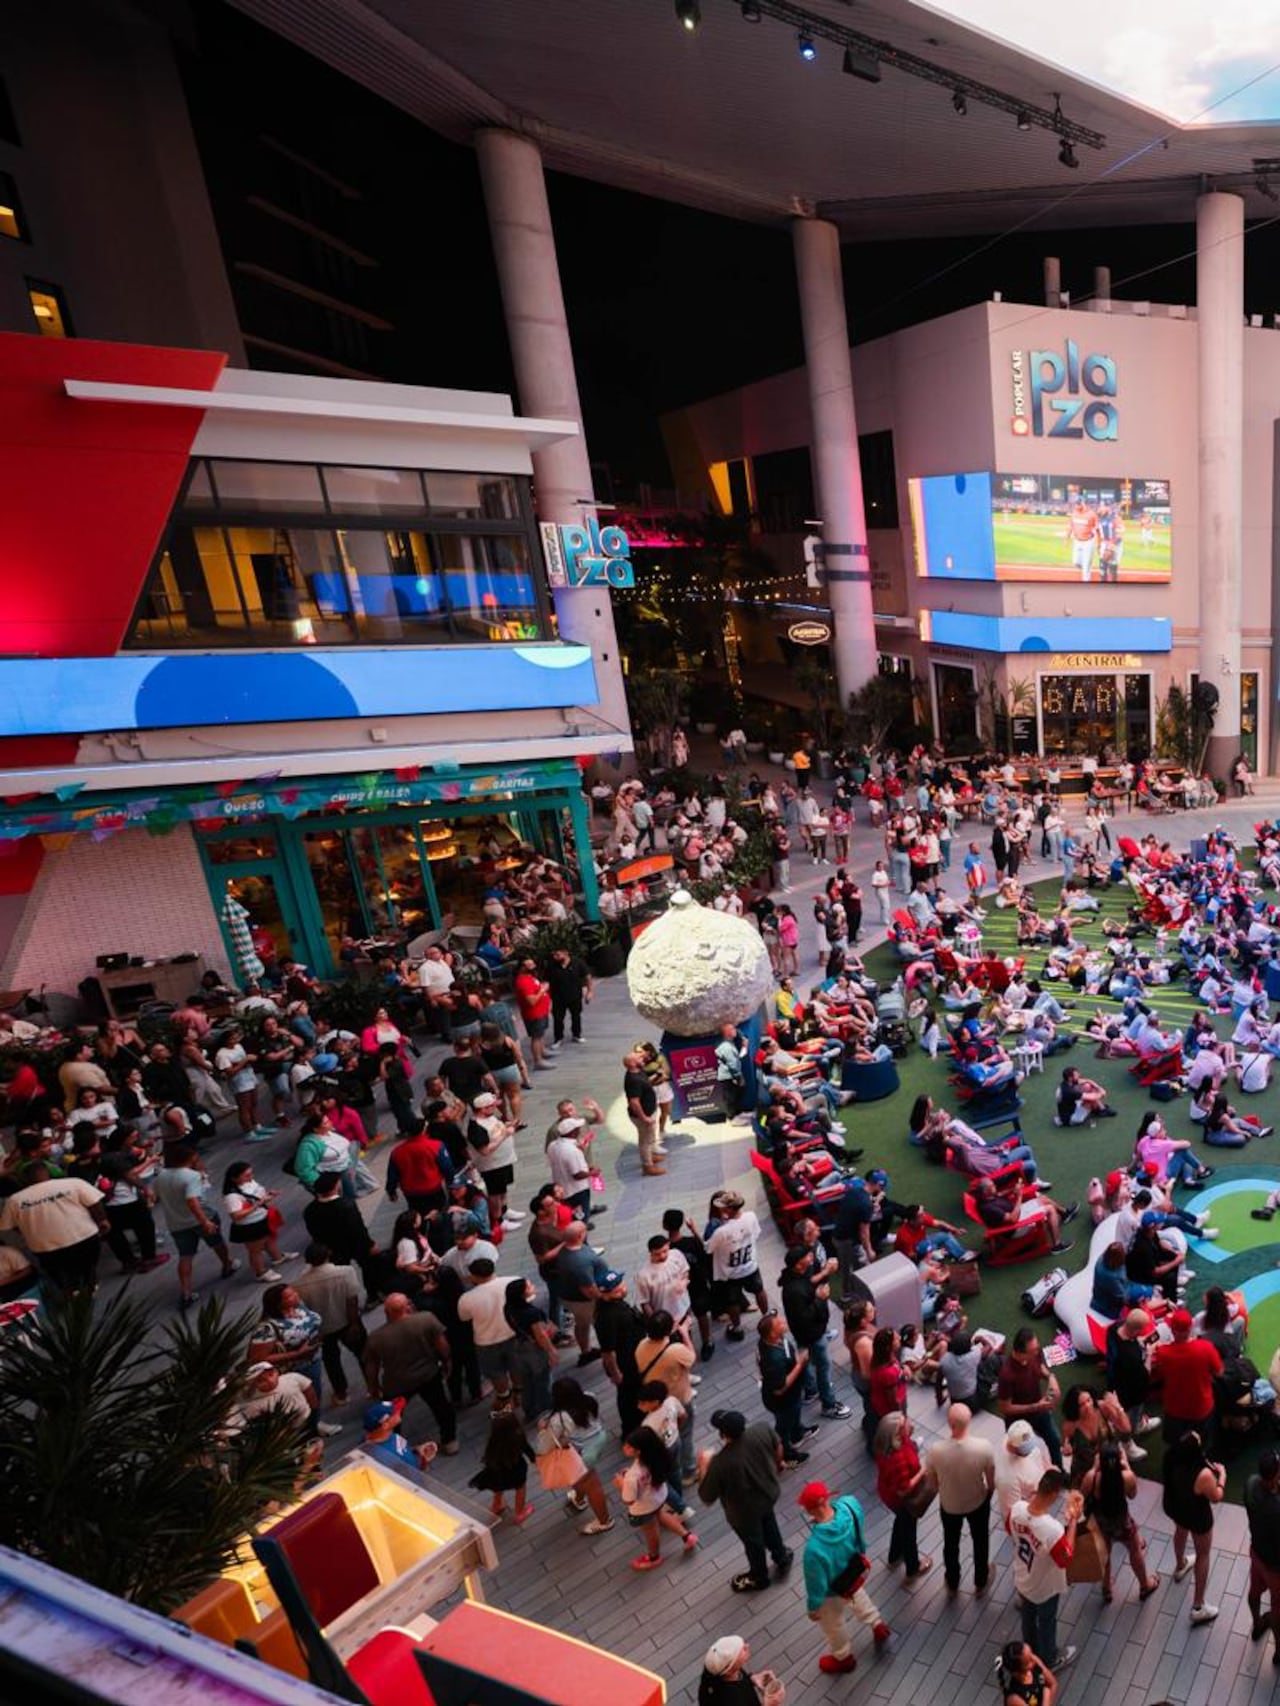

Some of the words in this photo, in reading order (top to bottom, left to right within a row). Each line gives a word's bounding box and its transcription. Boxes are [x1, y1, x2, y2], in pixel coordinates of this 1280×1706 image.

[1012, 350, 1024, 416] POPULAR
[1066, 655, 1124, 666] CENTRAL
[1047, 686, 1112, 714] BAR
[330, 792, 365, 803] CHIPS
[376, 787, 411, 799] SALSA
